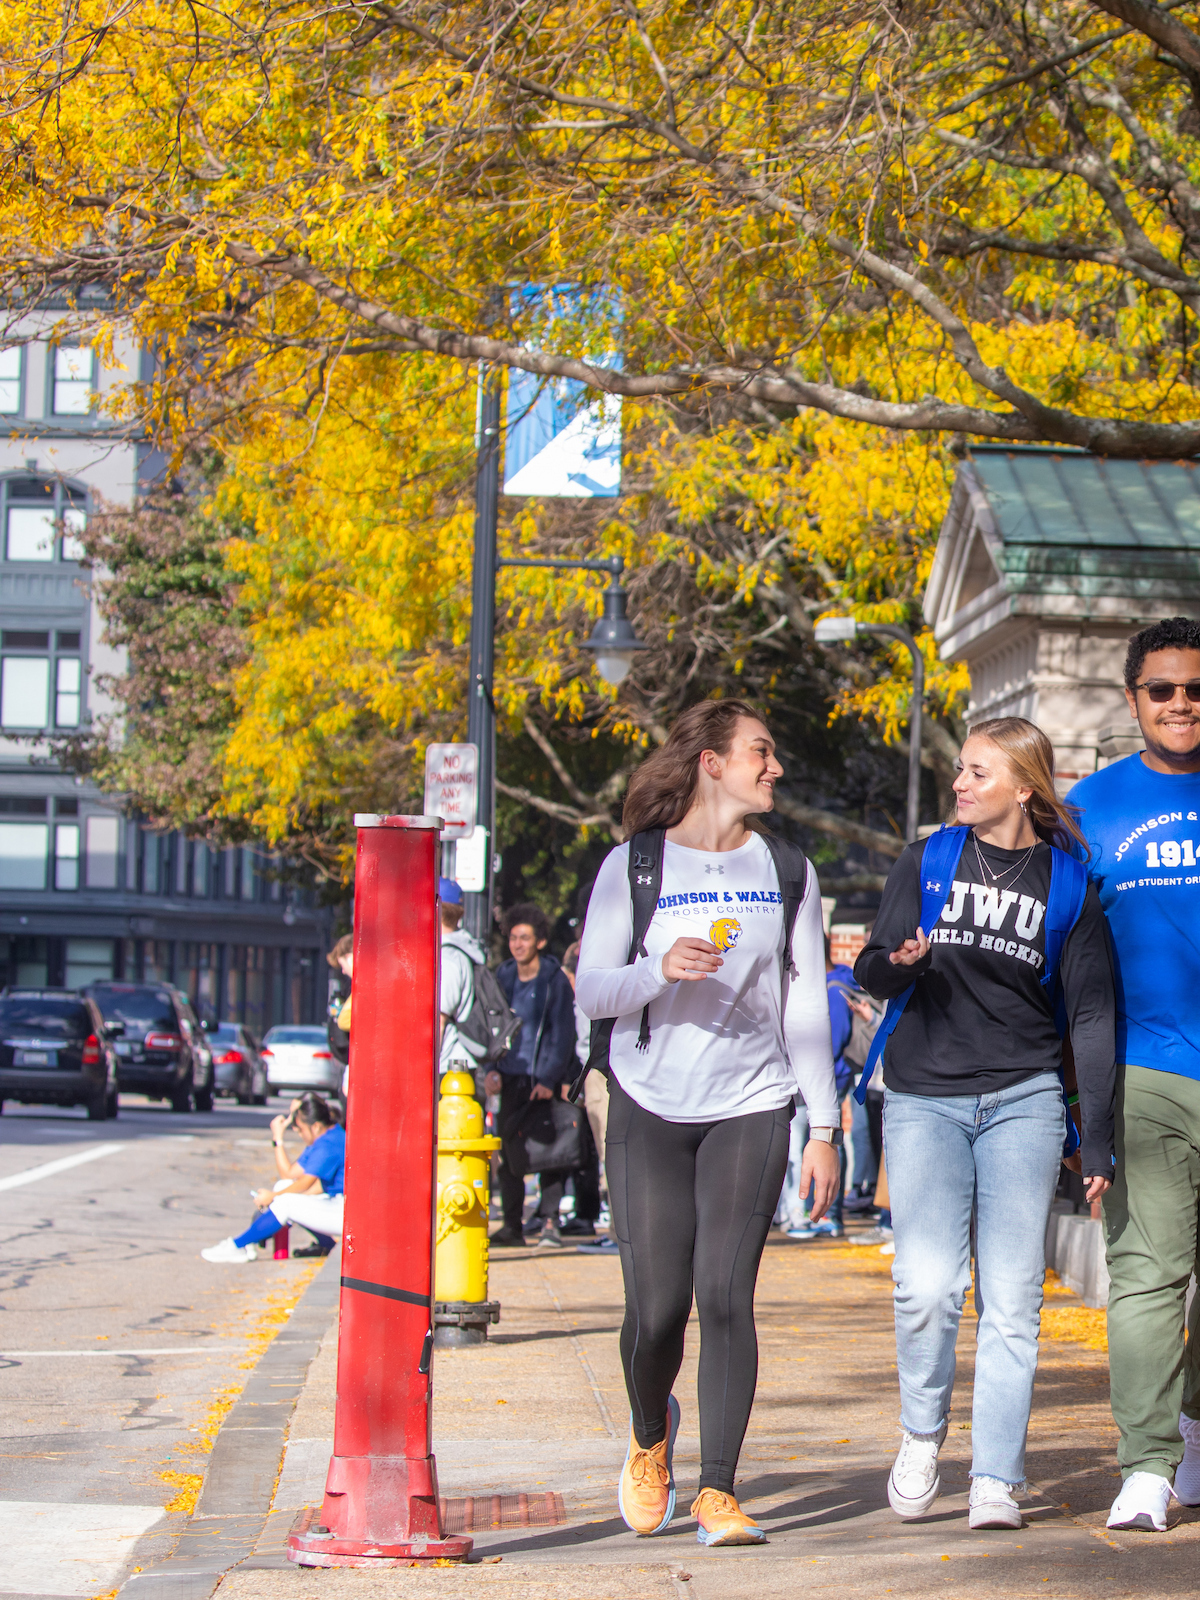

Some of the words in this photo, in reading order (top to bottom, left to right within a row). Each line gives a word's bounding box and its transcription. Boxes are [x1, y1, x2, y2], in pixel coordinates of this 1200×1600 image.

[443, 754, 460, 769] NO
[430, 772, 472, 784] PARKING
[440, 786, 461, 799] ANY
[440, 801, 461, 814] TIME
[1114, 811, 1182, 862] JOHNSON
[1187, 811, 1198, 821] &
[1116, 880, 1136, 892] NEW
[1138, 877, 1183, 887] STUDENT
[657, 892, 719, 909] OHNSON
[723, 892, 733, 903] &
[716, 906, 776, 914] COUNTRY
[941, 880, 1046, 941] JWU
